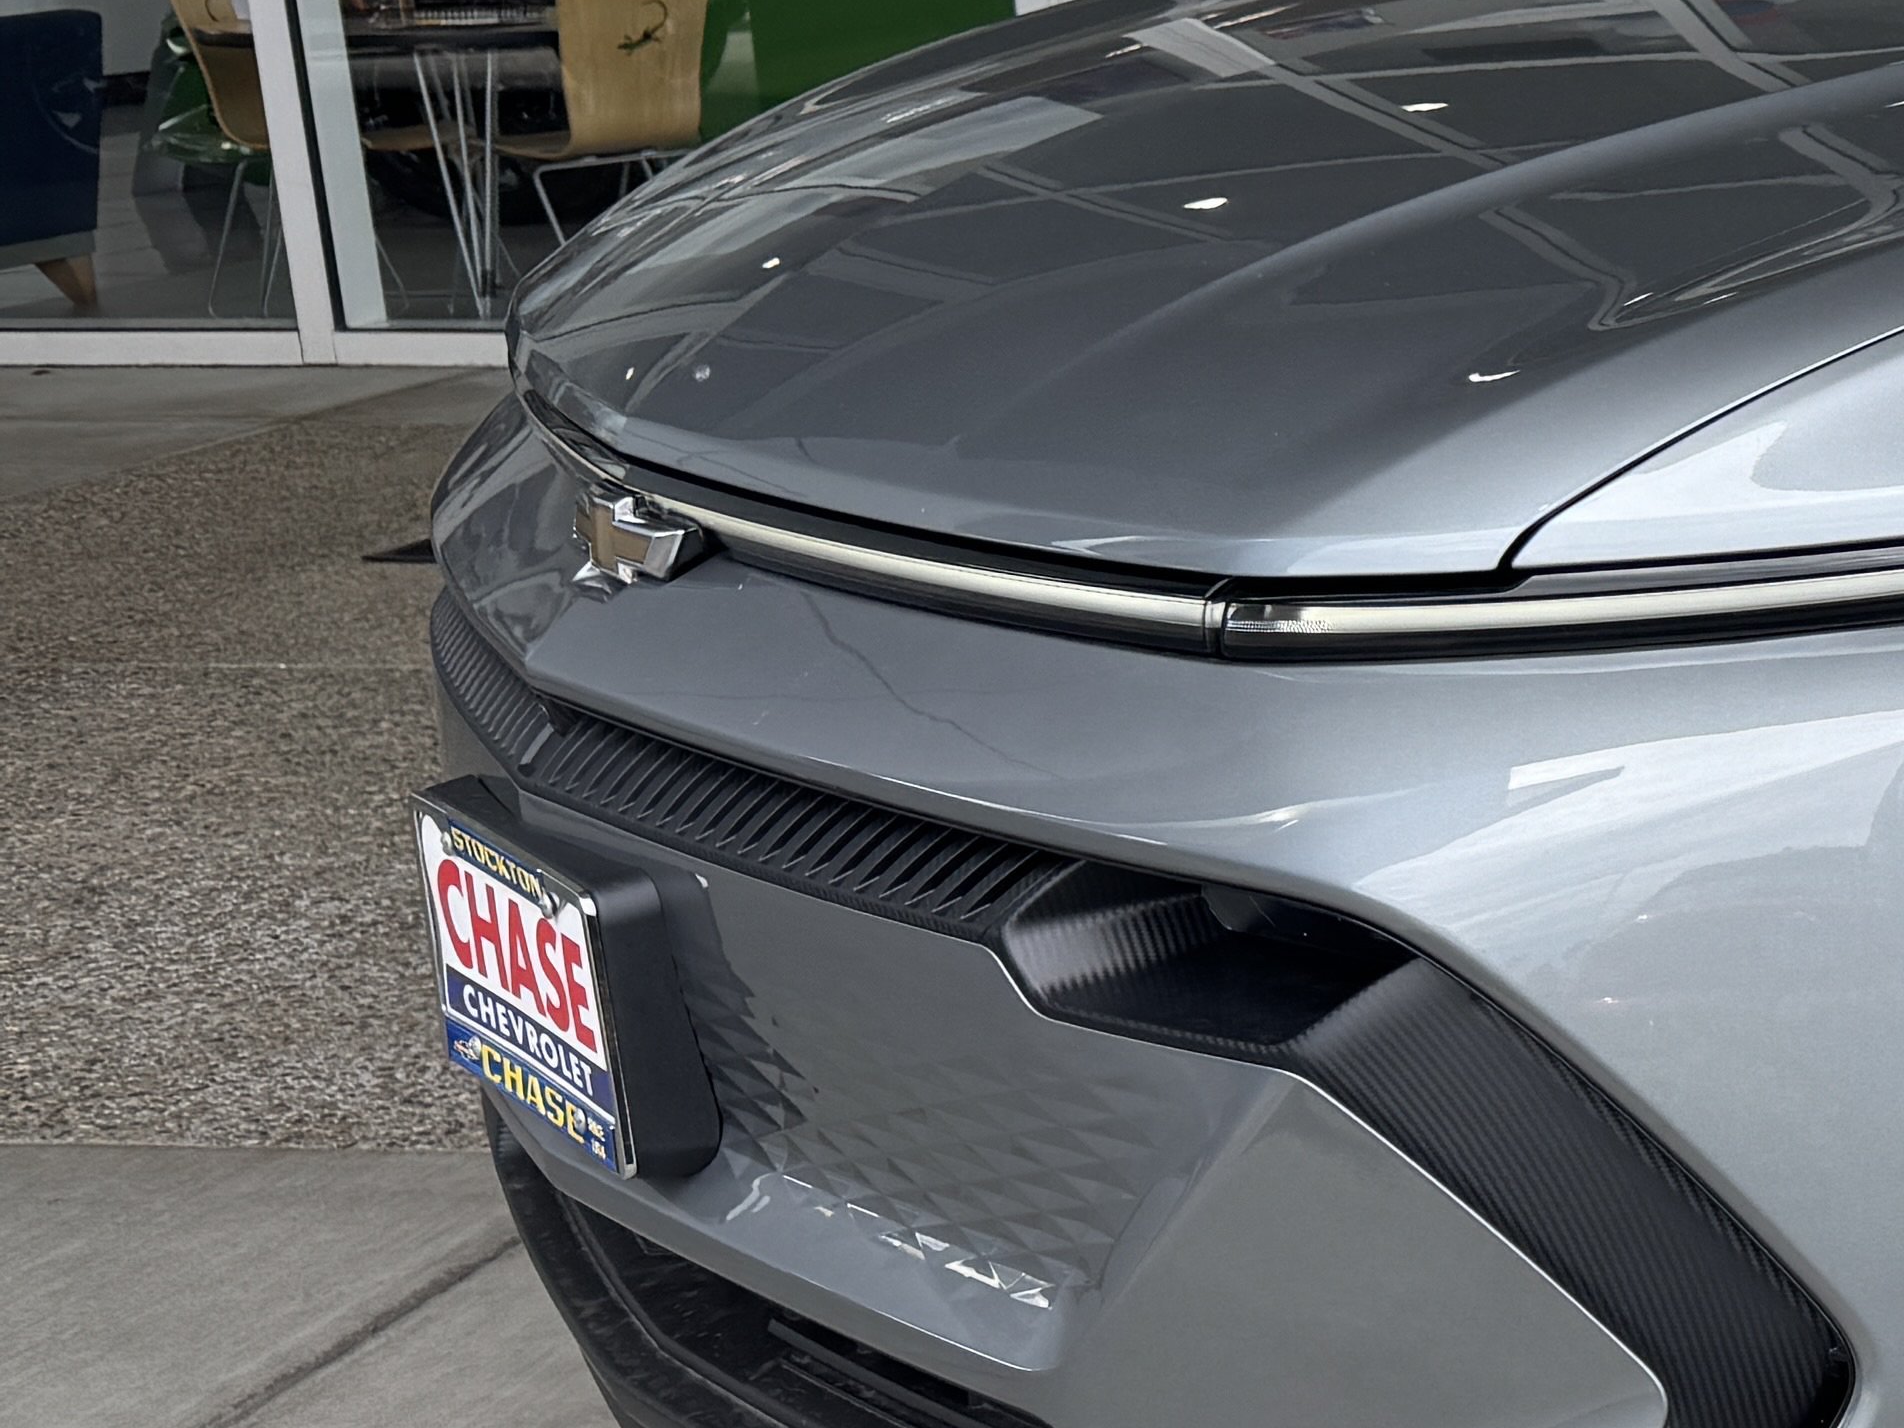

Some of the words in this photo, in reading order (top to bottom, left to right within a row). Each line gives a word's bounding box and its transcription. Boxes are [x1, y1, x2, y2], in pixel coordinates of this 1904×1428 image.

[451, 826, 543, 901] STOCKTON
[437, 858, 598, 1054] CHASE
[462, 983, 594, 1097] CHEVROLET
[480, 1043, 585, 1145] CHASE
